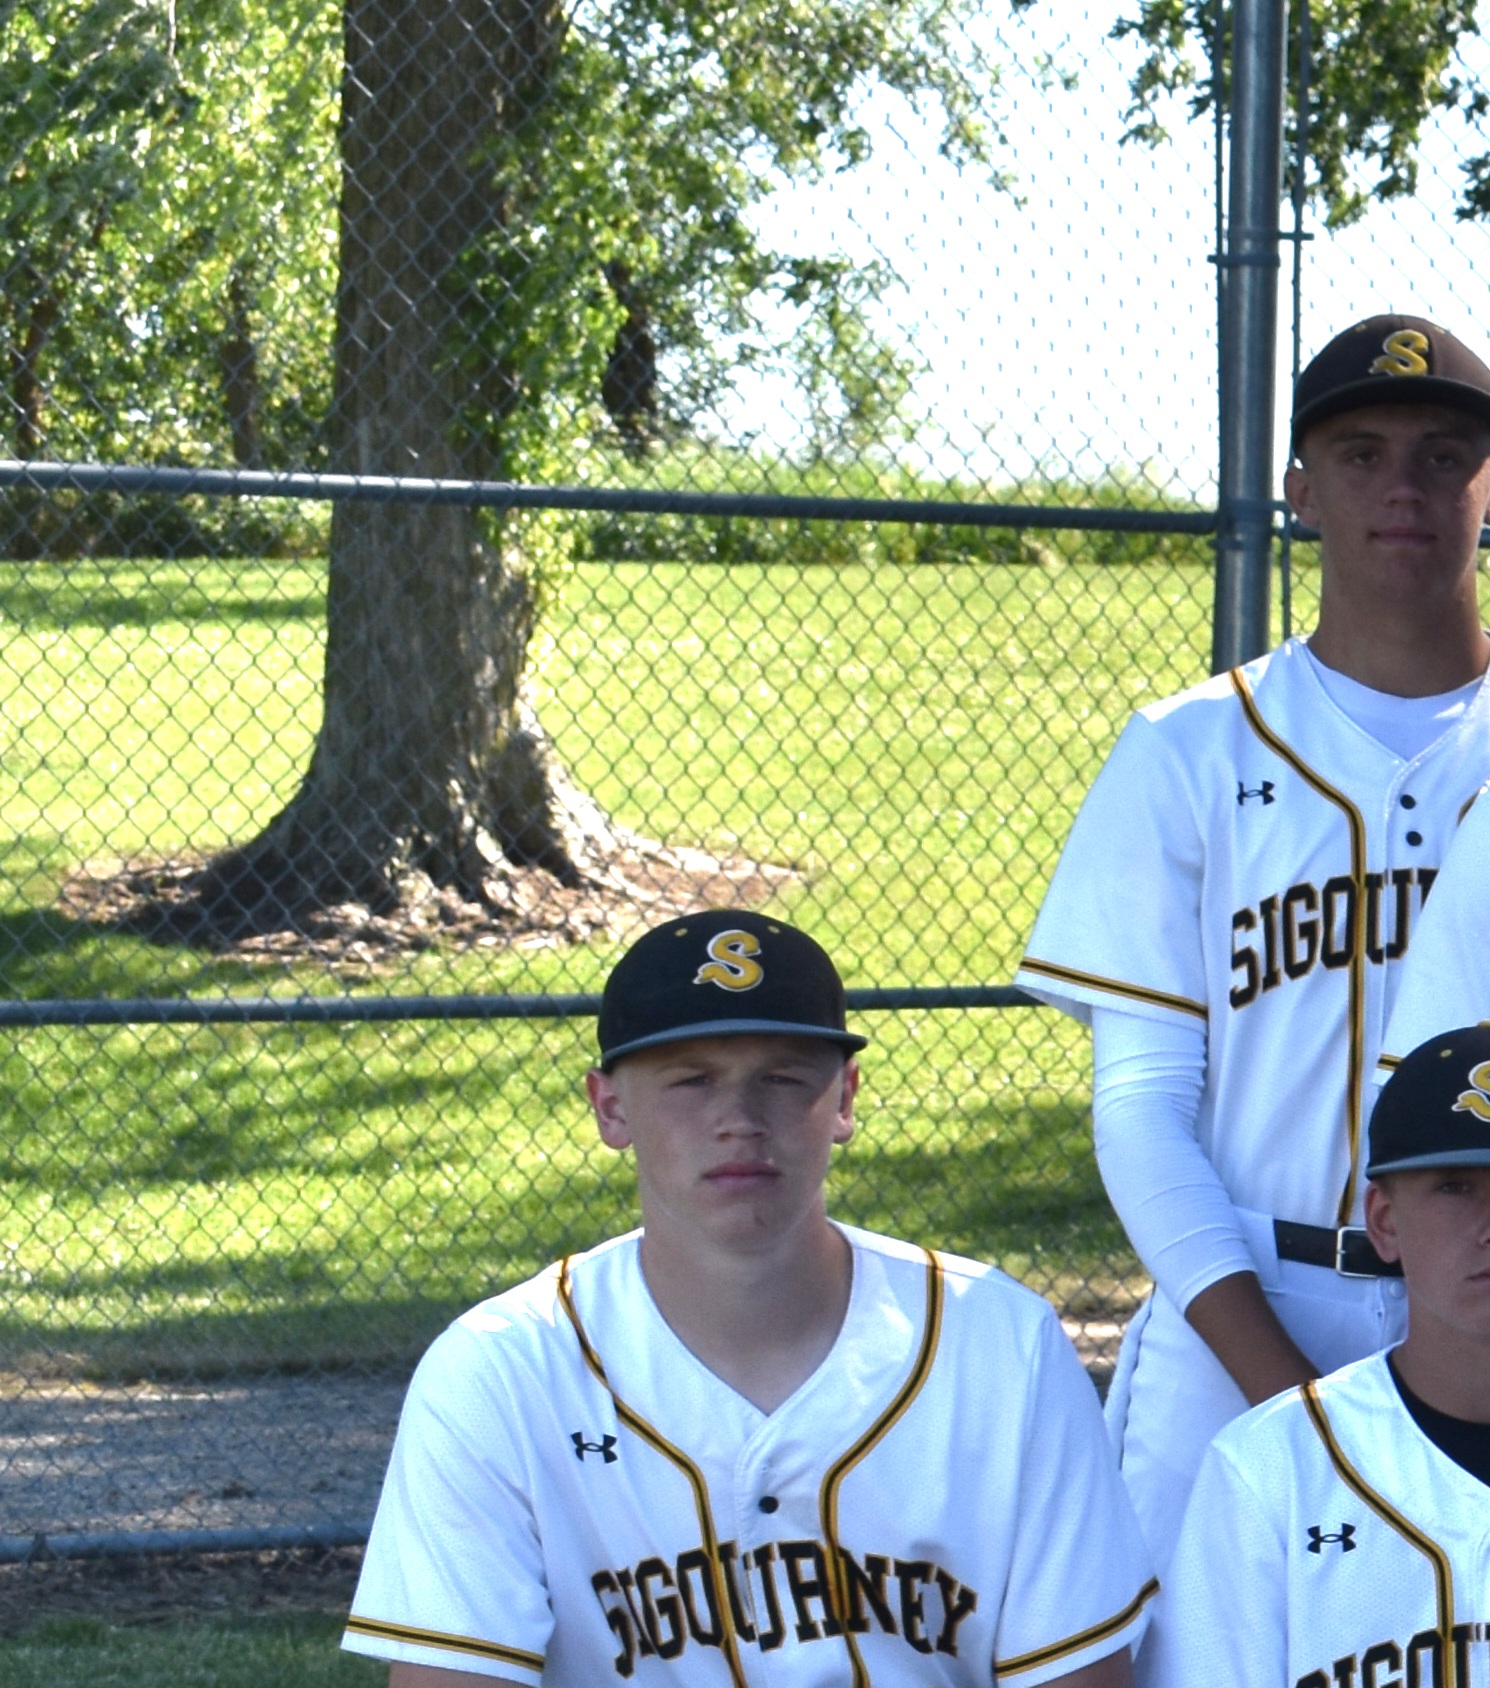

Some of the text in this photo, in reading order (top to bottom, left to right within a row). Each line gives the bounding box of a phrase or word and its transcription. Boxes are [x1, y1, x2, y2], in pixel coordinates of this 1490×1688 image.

[1369, 329, 1430, 378] S
[692, 928, 765, 992] S
[1229, 867, 1440, 1011] SIGOU
[591, 1539, 978, 1680] SIGOURNEY
